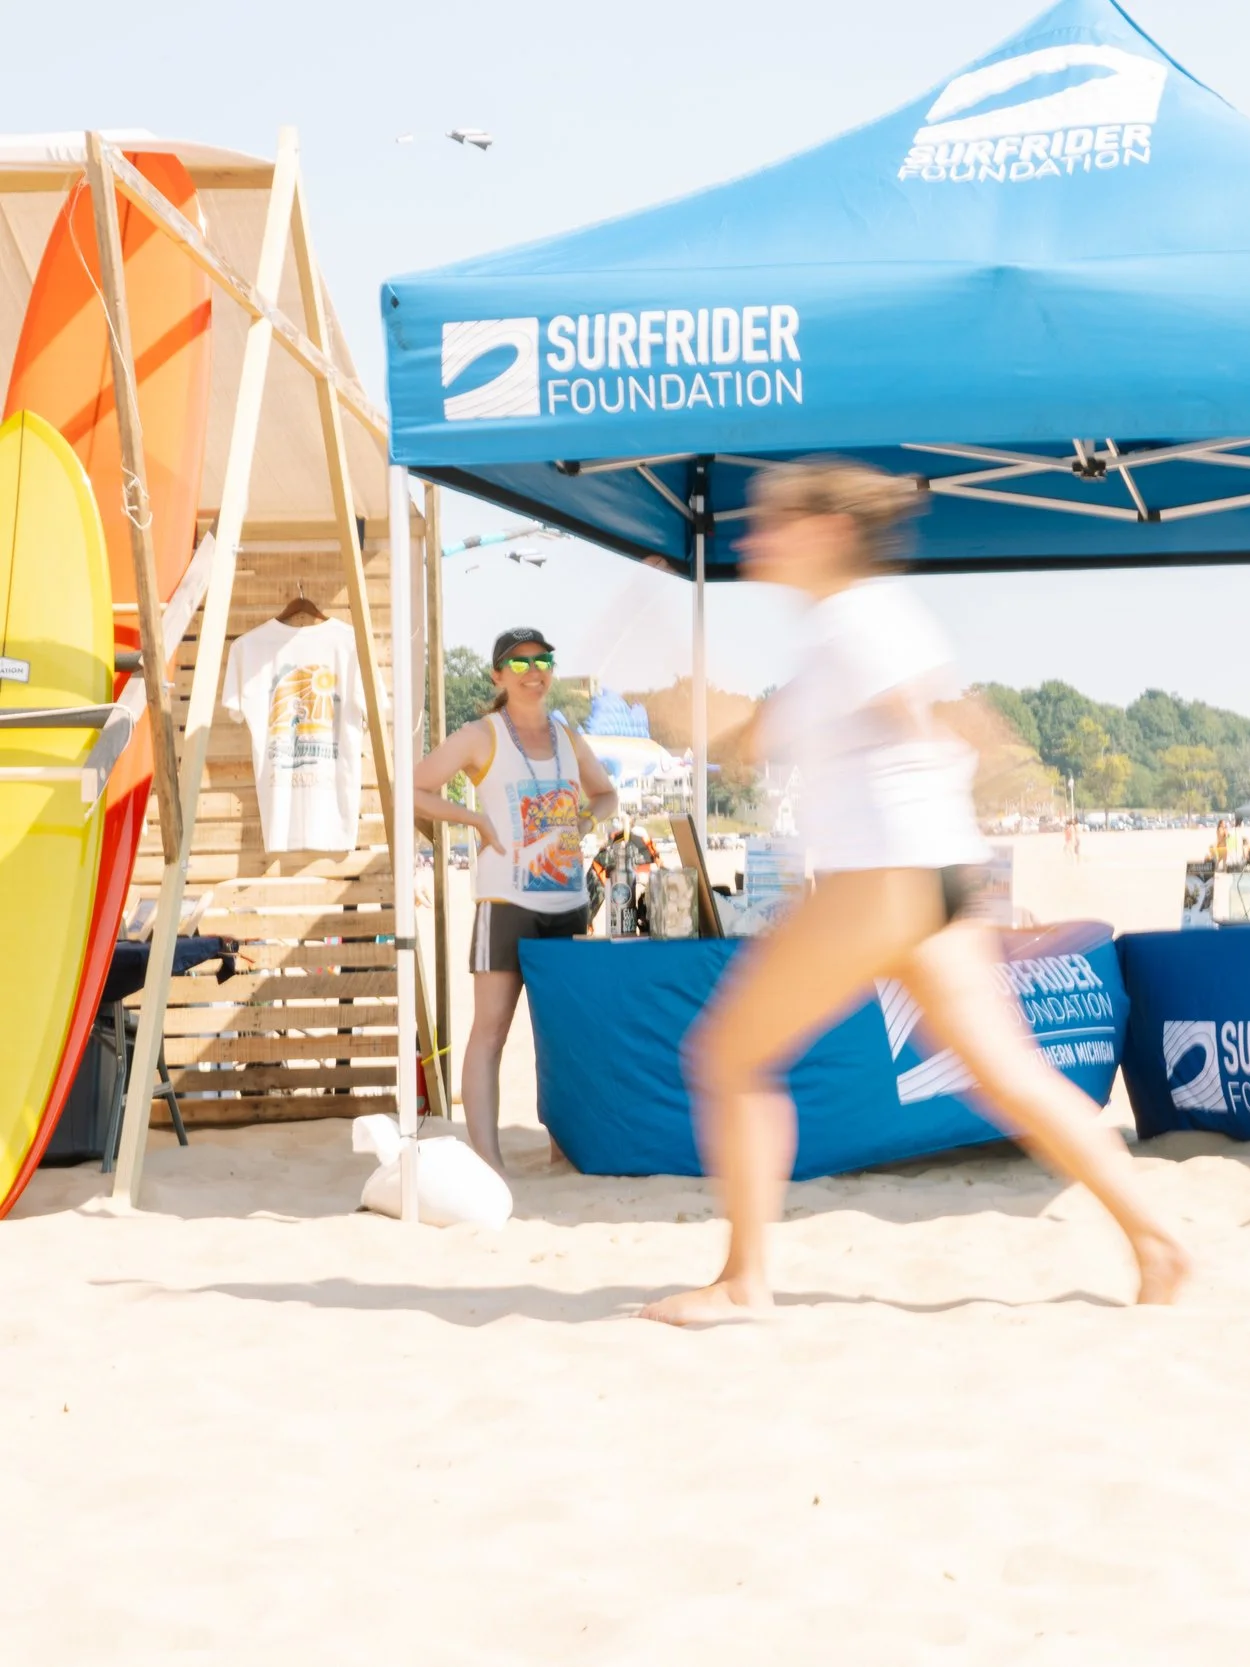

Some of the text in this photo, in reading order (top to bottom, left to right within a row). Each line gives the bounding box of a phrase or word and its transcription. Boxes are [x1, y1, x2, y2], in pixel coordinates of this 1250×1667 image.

[898, 147, 1151, 183] FOUNDATION
[904, 124, 1152, 168] SURFRIDER
[547, 306, 801, 372] SURFRIDER
[548, 368, 803, 415] FOUNDATION
[989, 954, 1103, 998] URFRIDER
